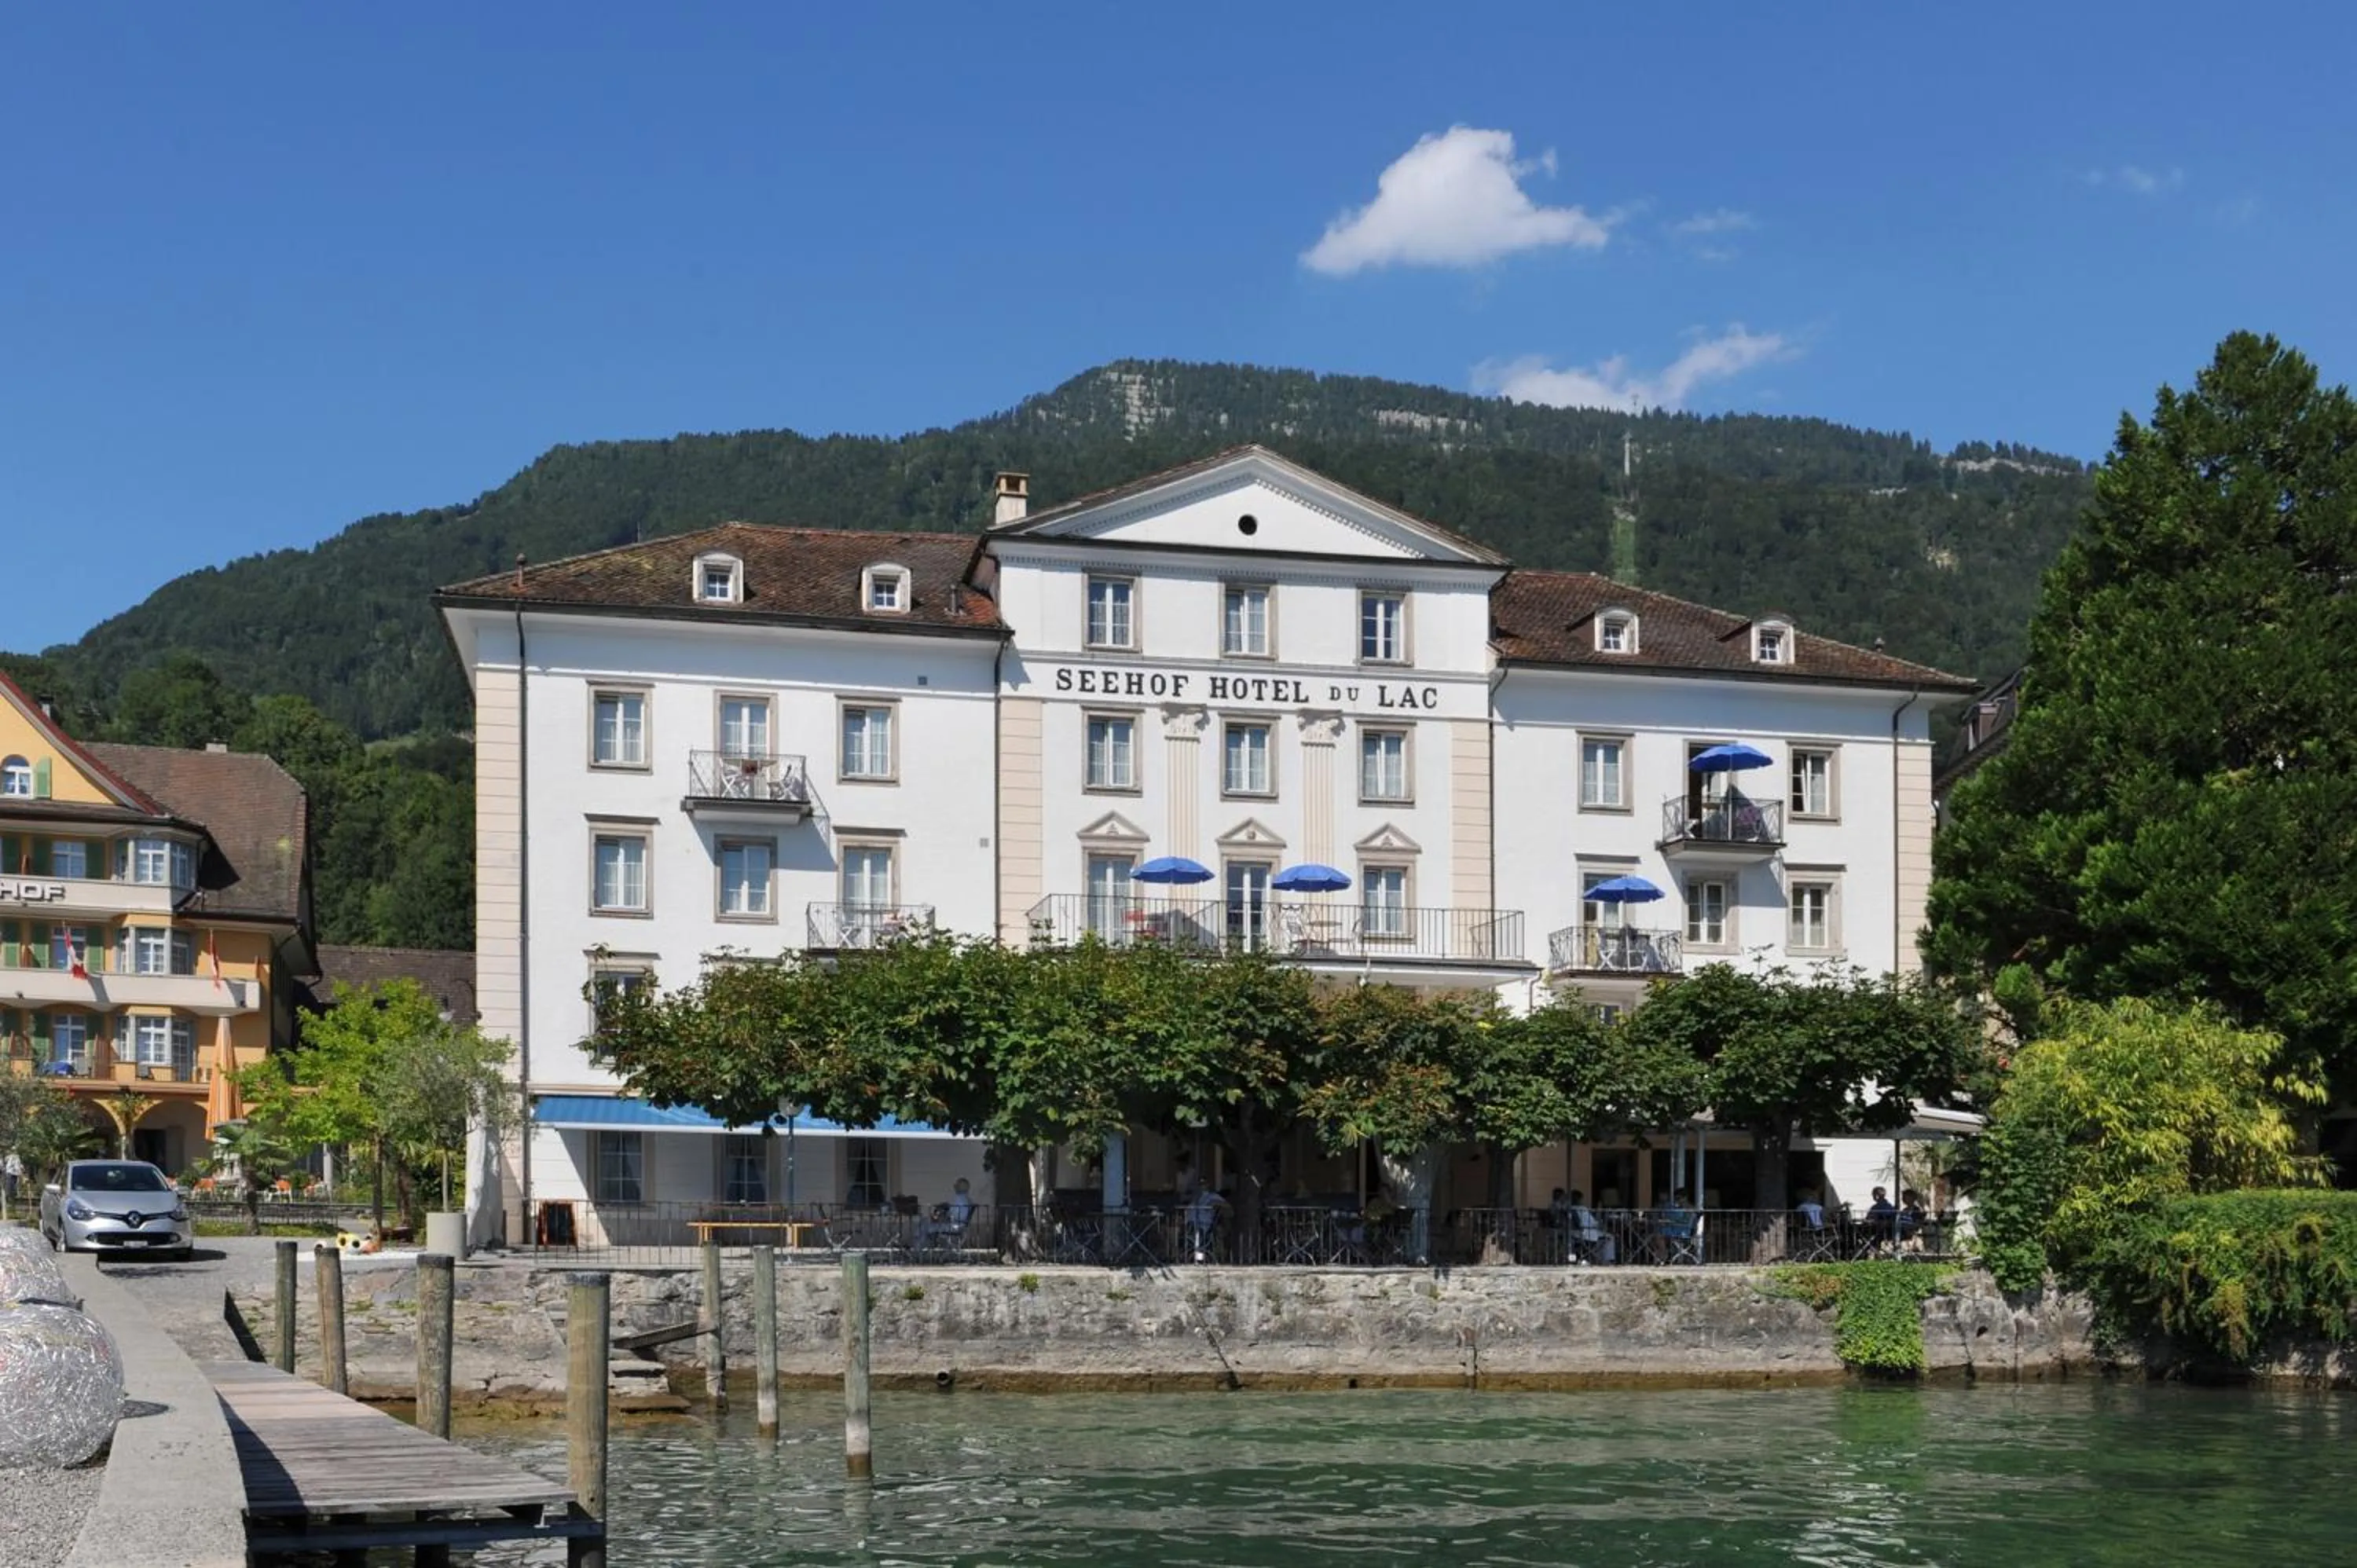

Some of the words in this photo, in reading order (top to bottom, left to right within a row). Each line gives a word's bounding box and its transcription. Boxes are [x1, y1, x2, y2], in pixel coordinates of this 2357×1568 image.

[1056, 667, 1189, 698] SEEHOF
[1208, 676, 1310, 704] HOTEL
[1329, 685, 1360, 702] DU
[1377, 684, 1439, 710] LAC
